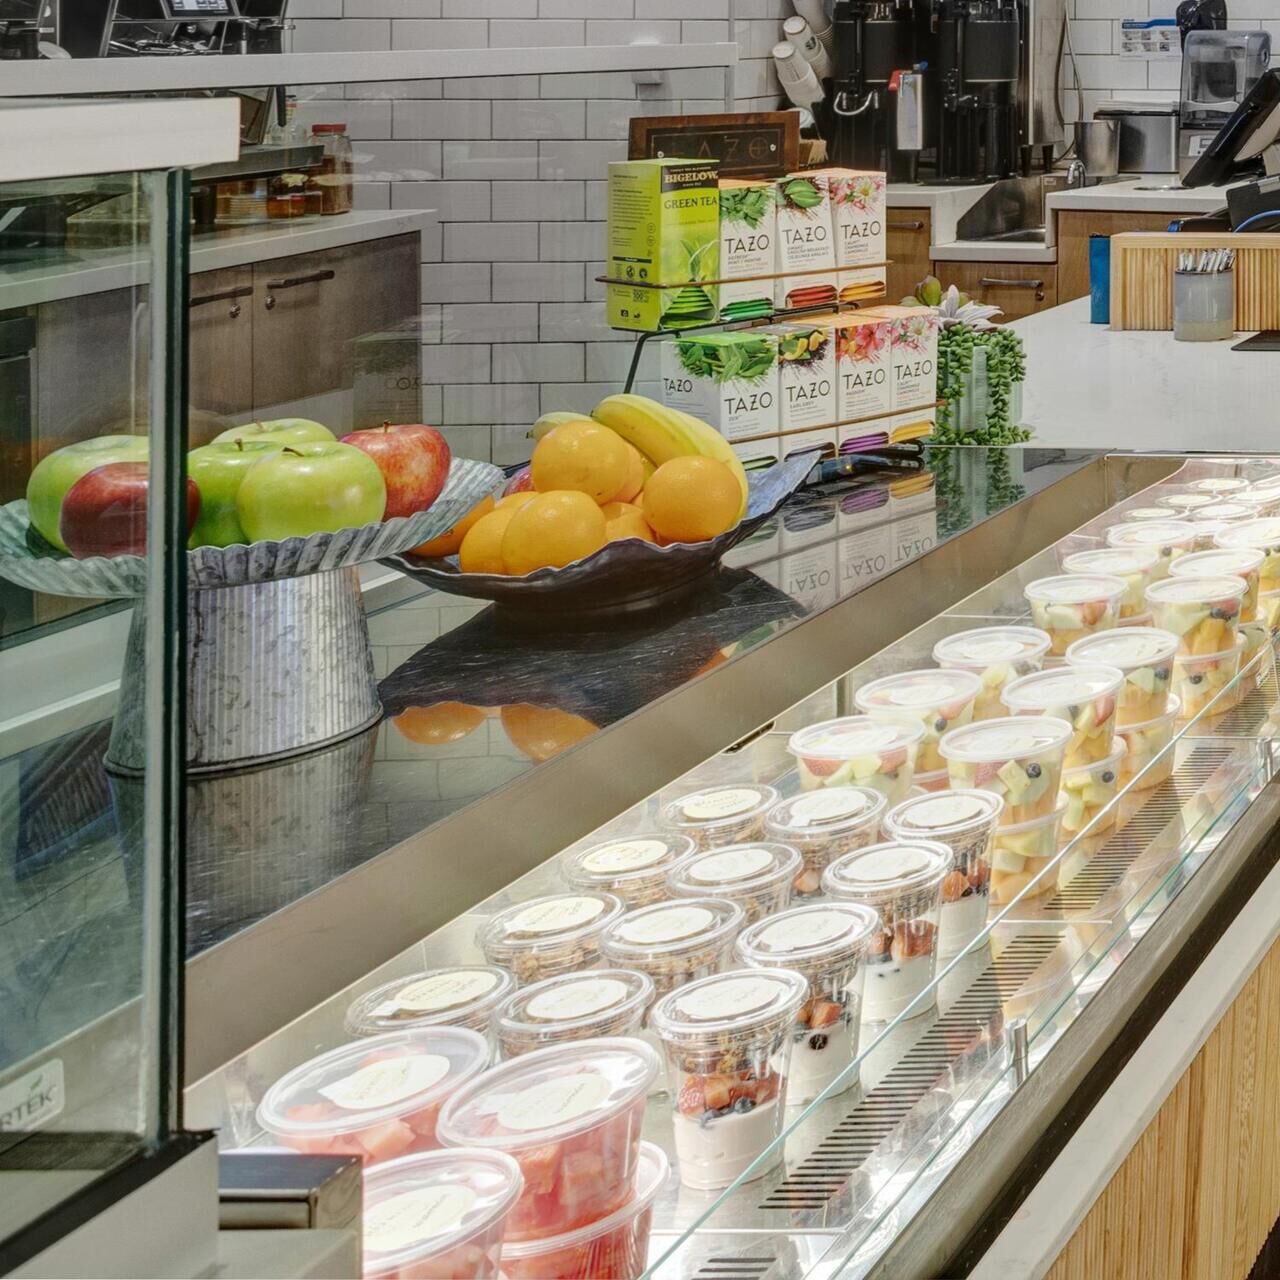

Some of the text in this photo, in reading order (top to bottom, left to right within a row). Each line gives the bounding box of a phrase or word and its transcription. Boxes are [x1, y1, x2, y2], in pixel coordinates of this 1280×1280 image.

[664, 171, 718, 184] BIGELOW
[664, 196, 718, 209] GREEN TEA
[782, 225, 827, 245] TAZO
[840, 220, 882, 239] TAZO
[724, 234, 770, 254] TAZO
[842, 368, 886, 390] TAZO
[894, 359, 933, 381] TAZO
[664, 377, 693, 393] TAZO
[786, 380, 831, 402] TAZO
[724, 391, 774, 415] TAZO
